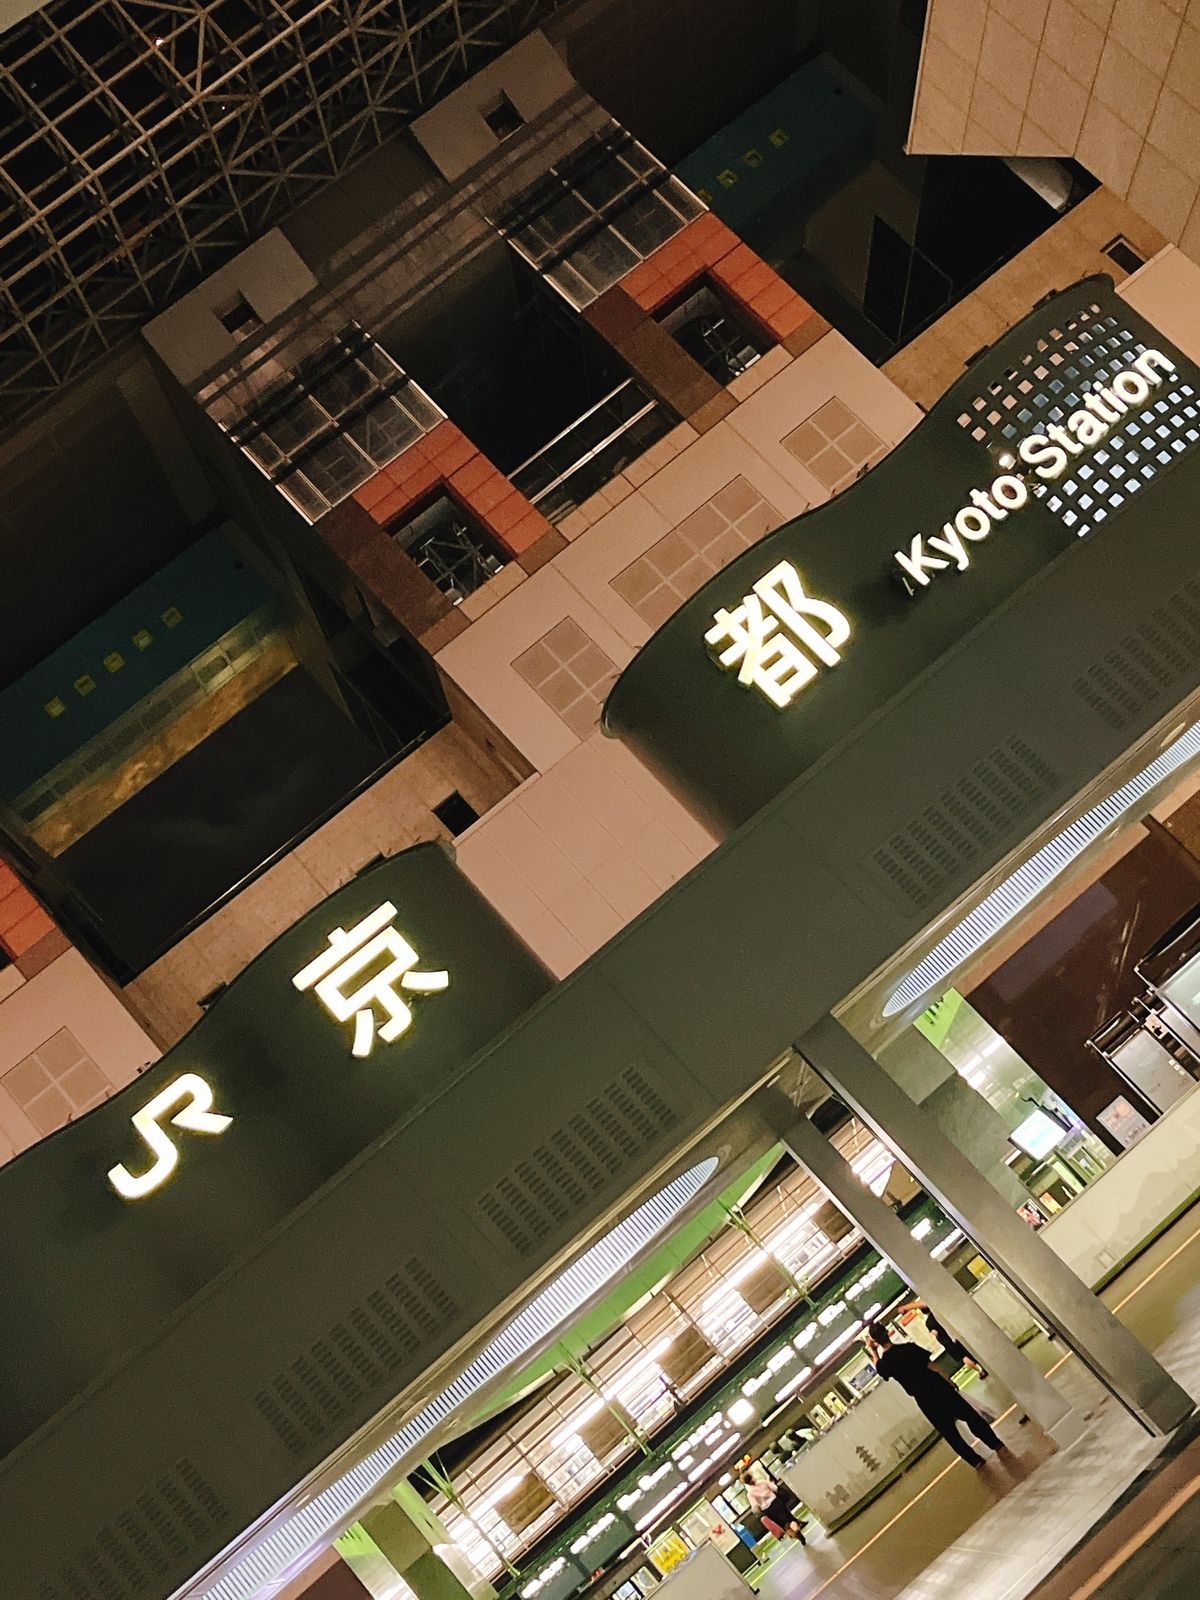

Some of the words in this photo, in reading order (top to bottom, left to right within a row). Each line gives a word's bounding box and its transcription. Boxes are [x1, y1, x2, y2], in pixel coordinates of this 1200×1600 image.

[107, 1072, 234, 1198] JR
[894, 475, 1028, 586] Kyoto
[1019, 349, 1176, 479] Station
